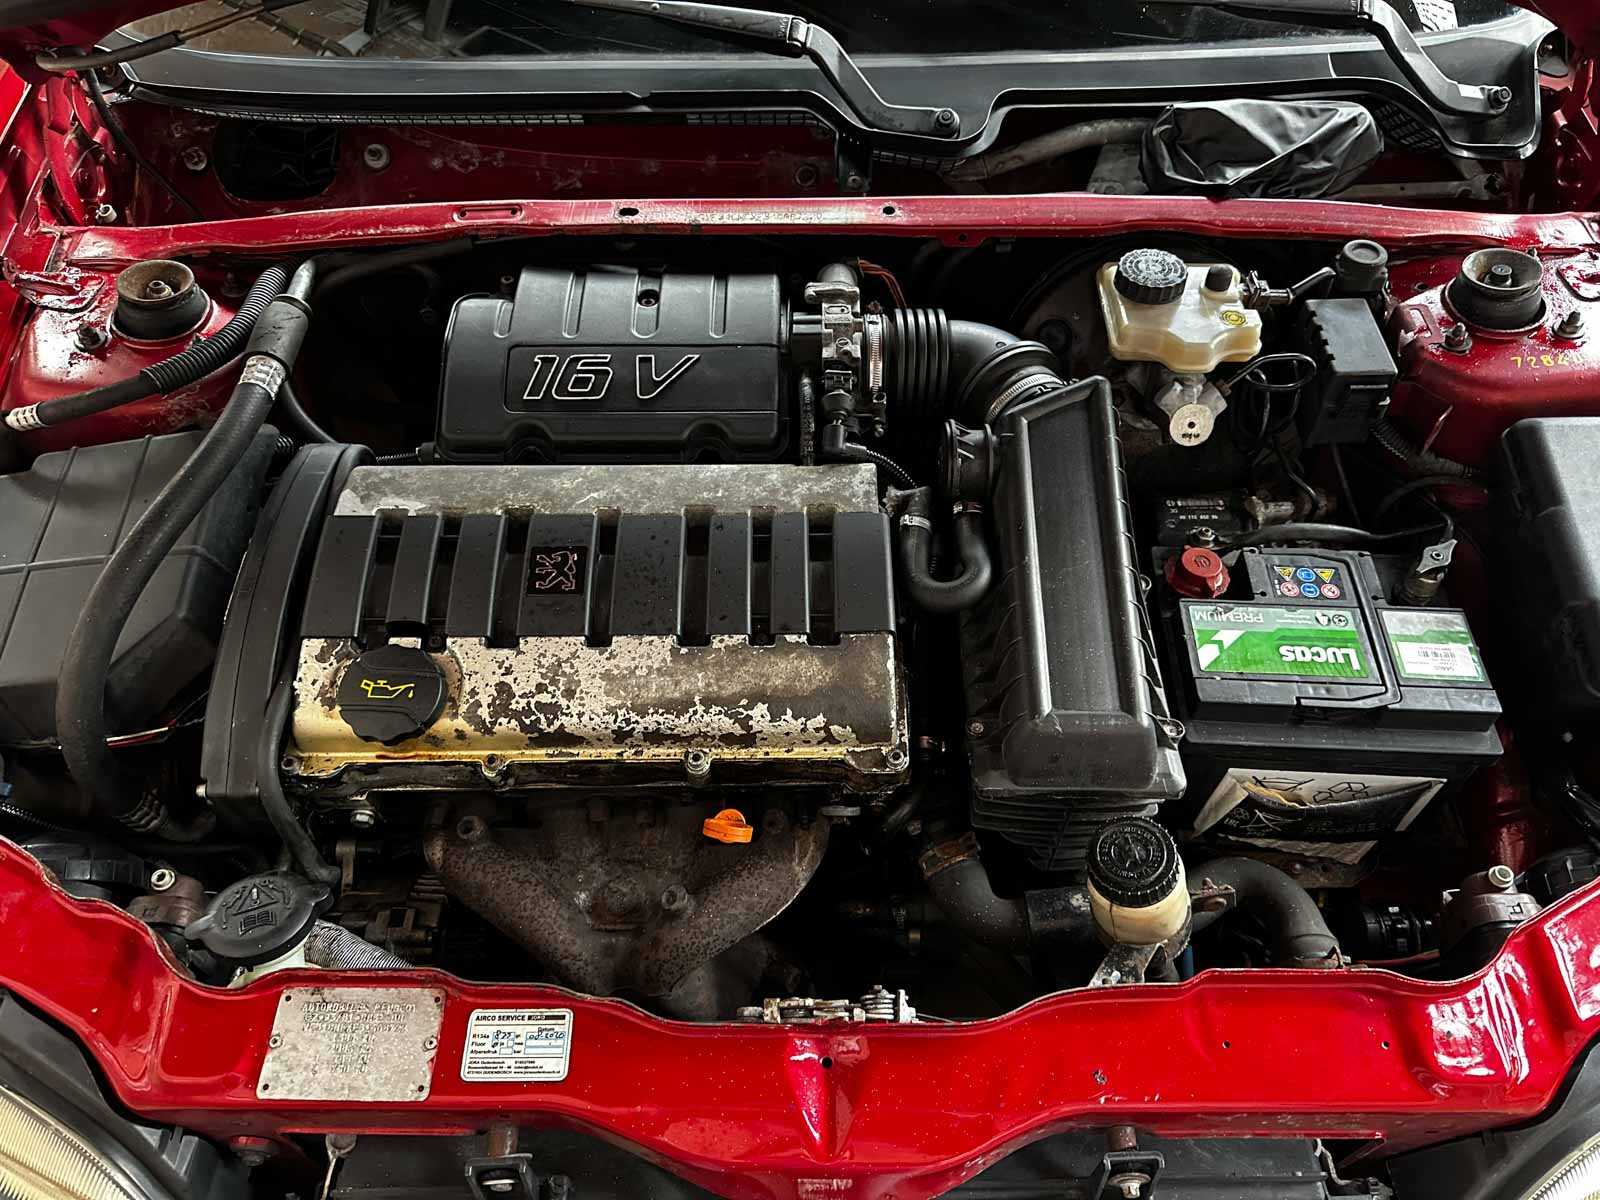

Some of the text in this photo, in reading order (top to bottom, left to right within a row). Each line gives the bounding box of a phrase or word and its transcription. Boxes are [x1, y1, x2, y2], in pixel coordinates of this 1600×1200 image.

[523, 354, 700, 400] 16 V
[1194, 610, 1265, 624] PREMIUM
[1279, 645, 1361, 671] Lucas
[475, 1014, 496, 1022] AIRCO
